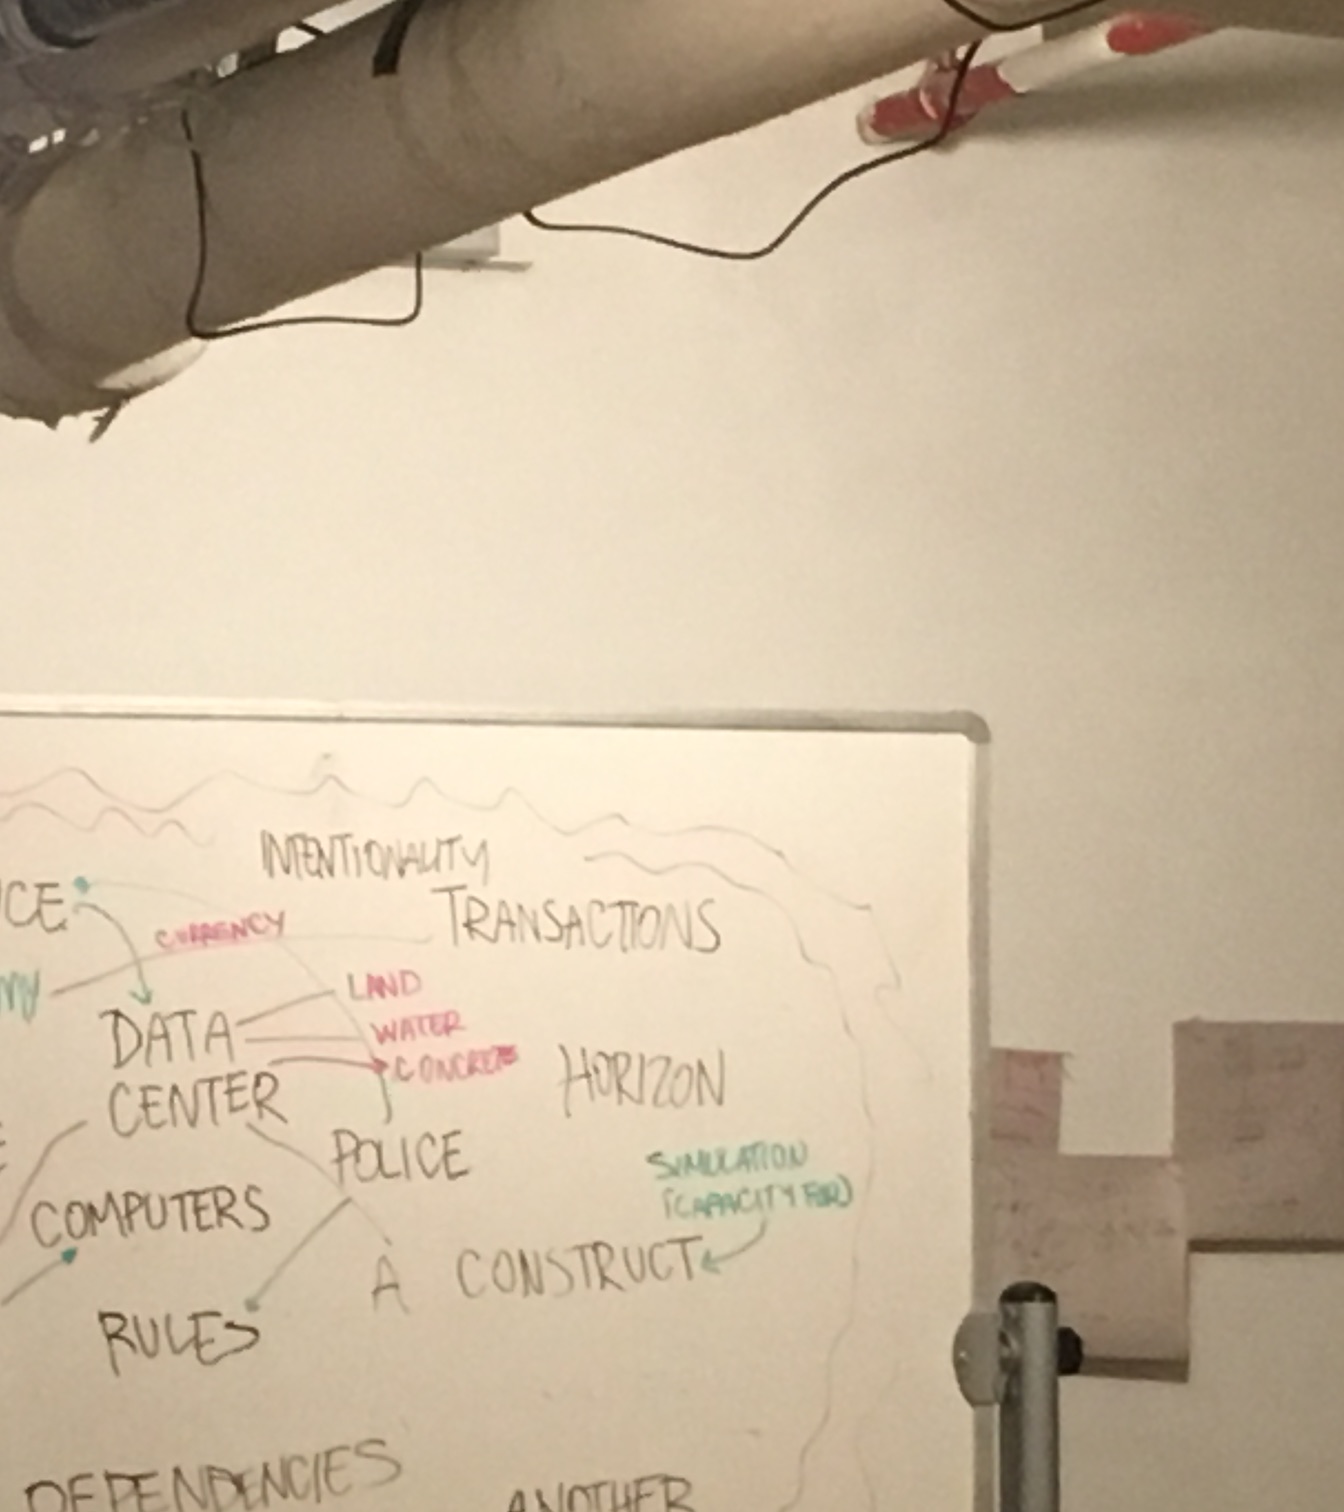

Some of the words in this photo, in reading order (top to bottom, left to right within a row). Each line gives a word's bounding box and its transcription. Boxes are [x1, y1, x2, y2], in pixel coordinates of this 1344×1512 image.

[261, 830, 490, 885] INTENTIONALITY
[431, 884, 722, 954] TRANSACTIONS
[347, 969, 421, 1001] LAND
[99, 1008, 235, 1070] DATA
[370, 1009, 467, 1045] WATER
[109, 1069, 288, 1138] CENTER
[558, 1043, 727, 1119] HORIZON
[330, 1128, 471, 1184] POLICE
[646, 1140, 808, 1180] SIMULATION
[31, 1185, 271, 1250] COMPUTERS
[370, 1254, 410, 1315] A
[456, 1234, 704, 1300] CONSTRUCT
[98, 1308, 262, 1378] RULES
